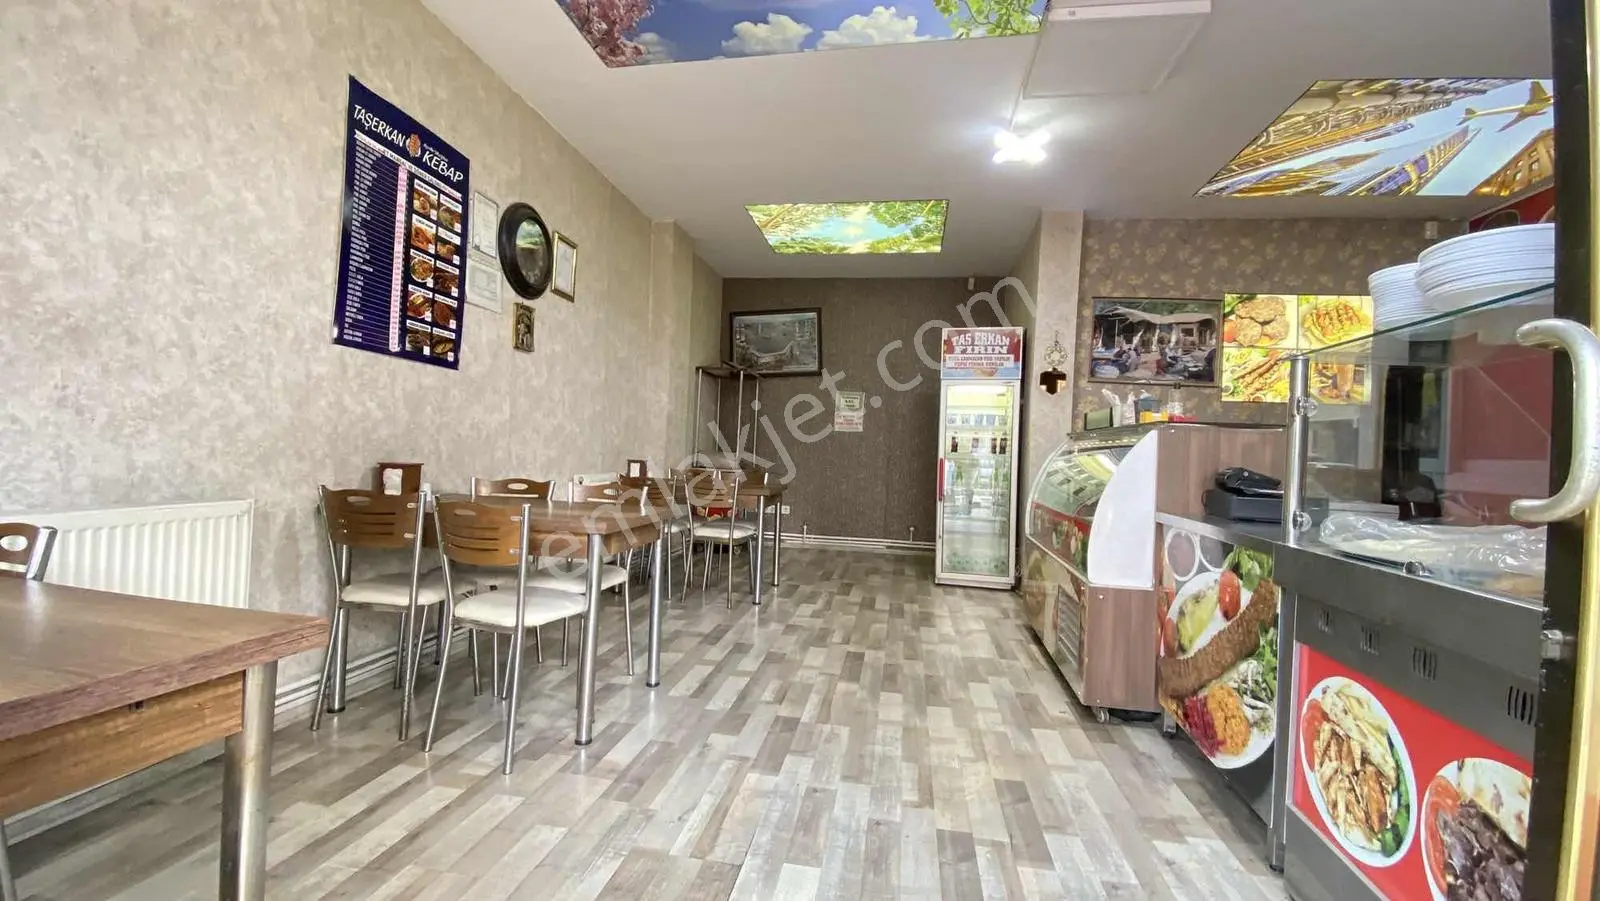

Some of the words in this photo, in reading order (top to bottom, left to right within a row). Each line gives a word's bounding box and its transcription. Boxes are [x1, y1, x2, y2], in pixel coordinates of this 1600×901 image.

[353, 104, 406, 147] TAŞERKAN
[422, 151, 464, 183] KEBAP
[974, 332, 1010, 346] ERKAN
